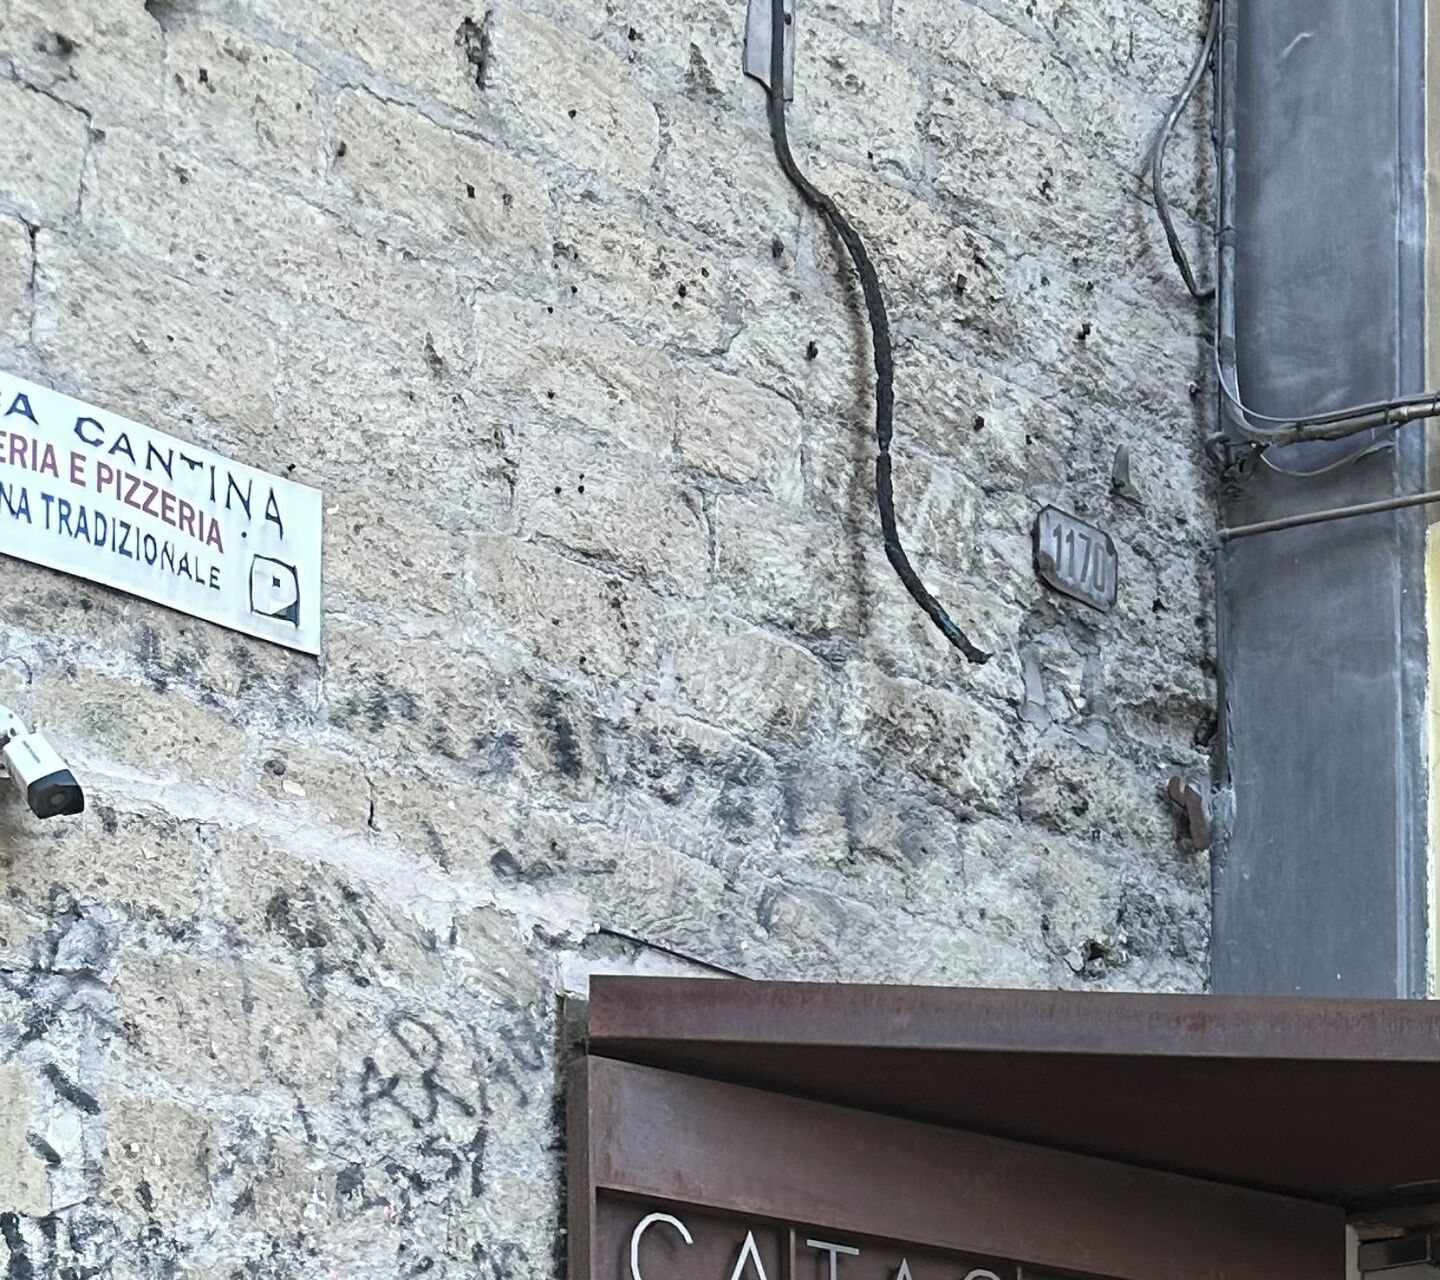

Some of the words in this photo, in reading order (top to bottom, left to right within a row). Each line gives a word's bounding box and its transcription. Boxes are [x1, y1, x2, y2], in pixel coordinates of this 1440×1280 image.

[0, 391, 40, 426] A
[73, 416, 285, 541] CANTINA
[69, 450, 87, 488] E
[96, 460, 225, 554] PIZZERIA
[40, 491, 222, 591] TRADIZIONALE
